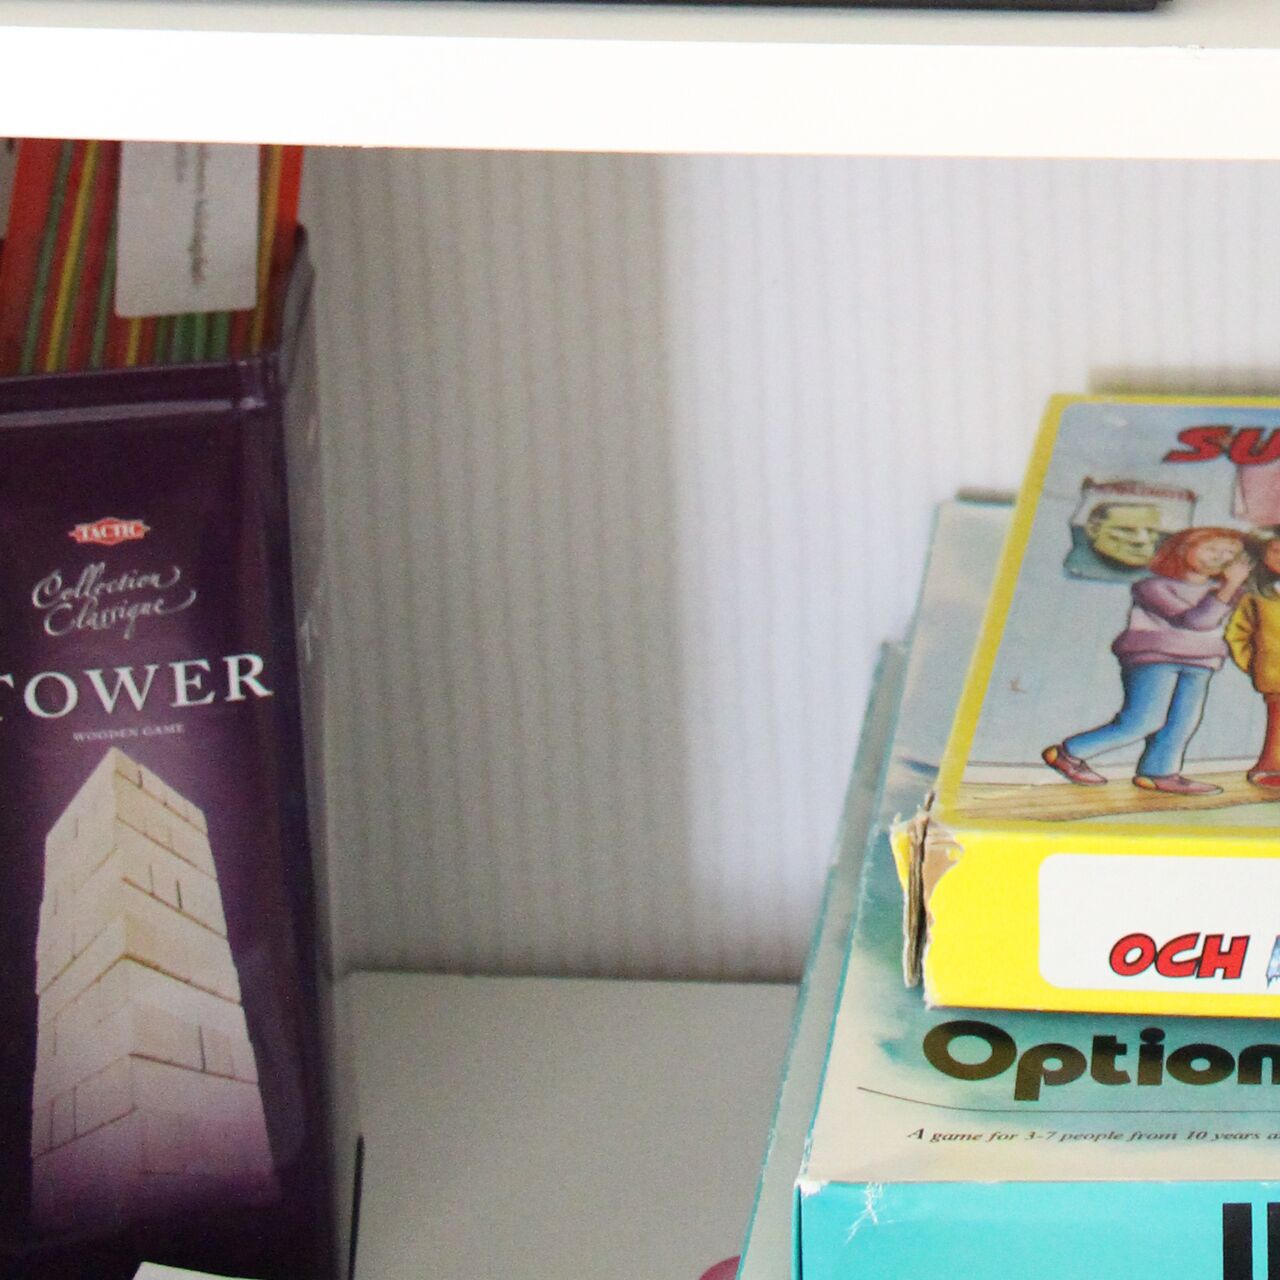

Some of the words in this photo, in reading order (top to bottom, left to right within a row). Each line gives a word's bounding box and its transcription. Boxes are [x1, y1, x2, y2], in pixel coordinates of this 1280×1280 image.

[78, 521, 143, 541] TACTIC
[32, 561, 183, 611] Collection
[141, 722, 186, 737] GAME
[1109, 932, 1251, 981] OCH
[906, 1126, 926, 1140] A
[930, 1129, 984, 1144] game
[984, 1128, 1020, 1144] for
[1025, 1128, 1057, 1142] 3-7
[1060, 1129, 1126, 1144] people
[1128, 1127, 1179, 1144] from
[1186, 1128, 1209, 1141] 10
[1213, 1130, 1261, 1143] years
